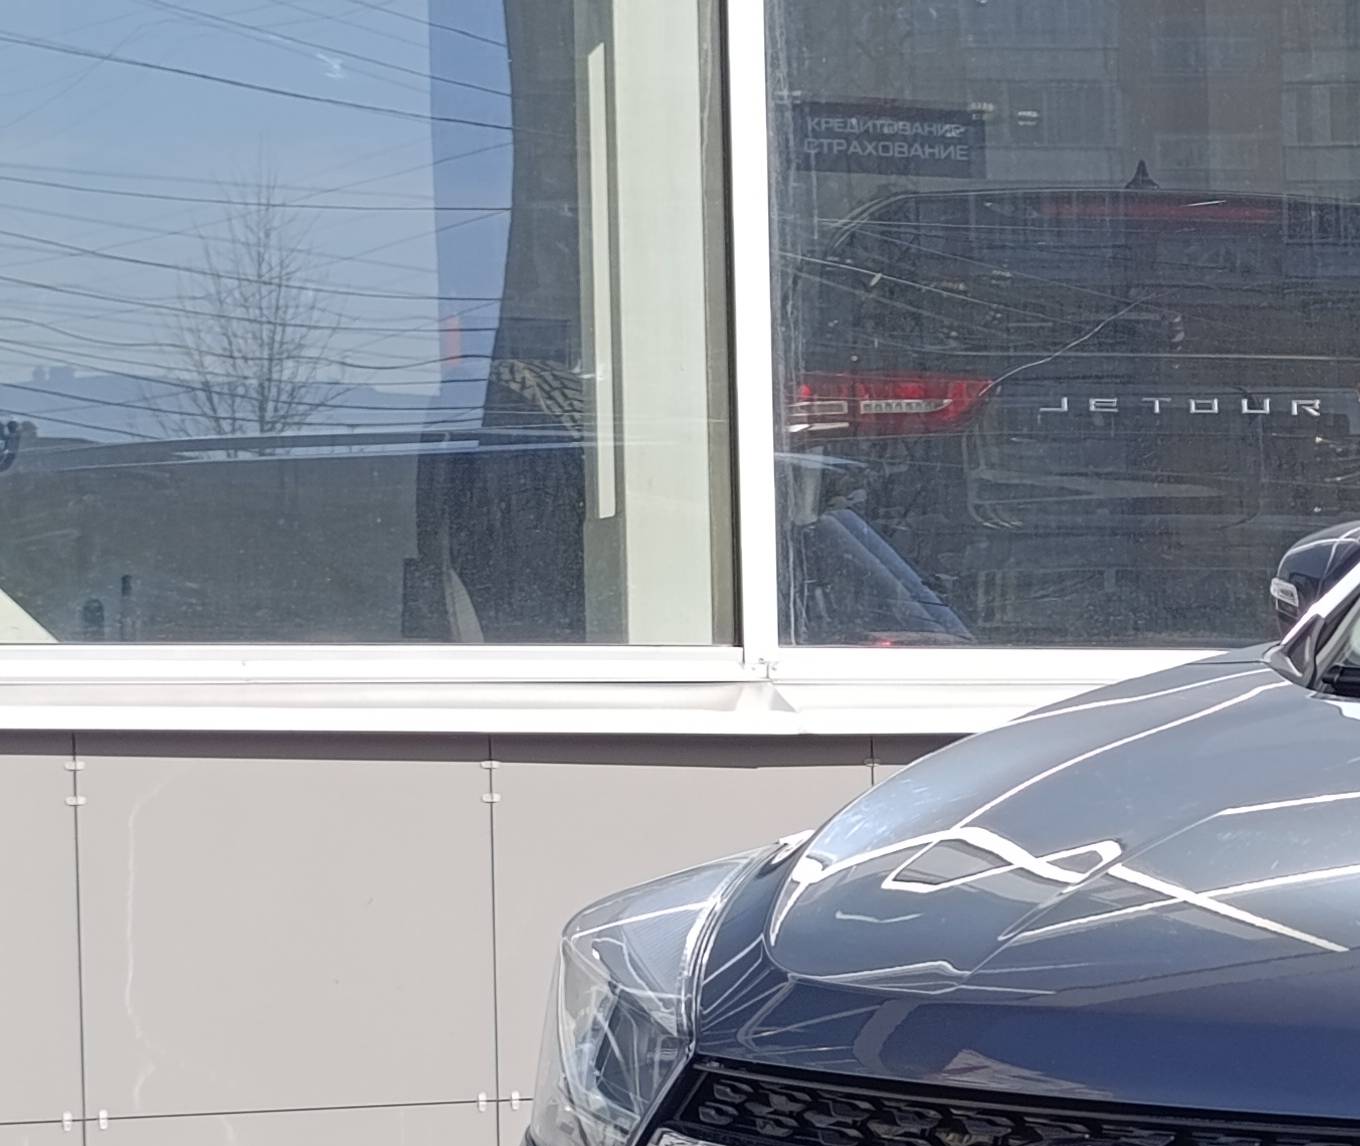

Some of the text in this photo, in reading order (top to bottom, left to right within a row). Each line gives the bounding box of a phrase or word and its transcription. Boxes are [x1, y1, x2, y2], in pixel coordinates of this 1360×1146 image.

[805, 116, 965, 137] КРЕДИТОВАНИЕ
[803, 138, 969, 161] СТРАХОВАНИЕ
[1039, 397, 1321, 416] JETOUR
